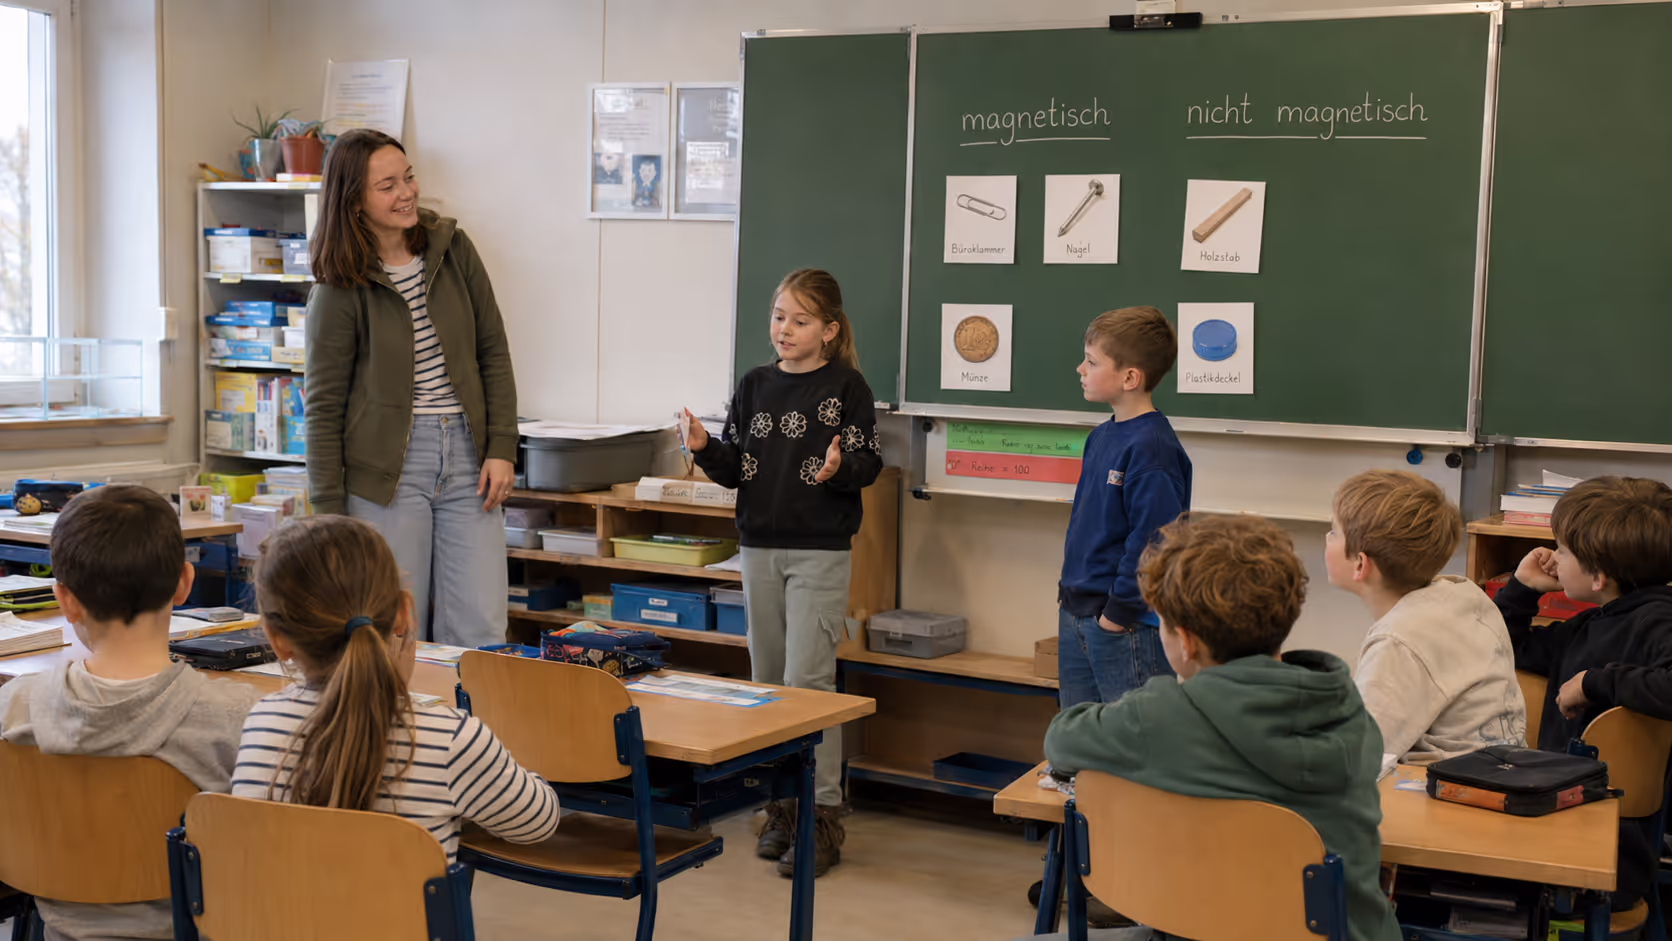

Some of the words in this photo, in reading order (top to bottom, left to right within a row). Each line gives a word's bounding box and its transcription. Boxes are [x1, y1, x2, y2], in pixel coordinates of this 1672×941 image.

[962, 97, 1111, 145] magnetisch
[1187, 93, 1252, 125] nicht
[1277, 91, 1428, 140] magnetisch
[951, 242, 1006, 254] Büroklammer
[1066, 242, 1091, 259] Nagel
[1200, 250, 1241, 262] Holzstab
[961, 371, 989, 383] Münze
[1185, 371, 1241, 384] Plastikdeckel
[1014, 465, 1030, 475] 100
